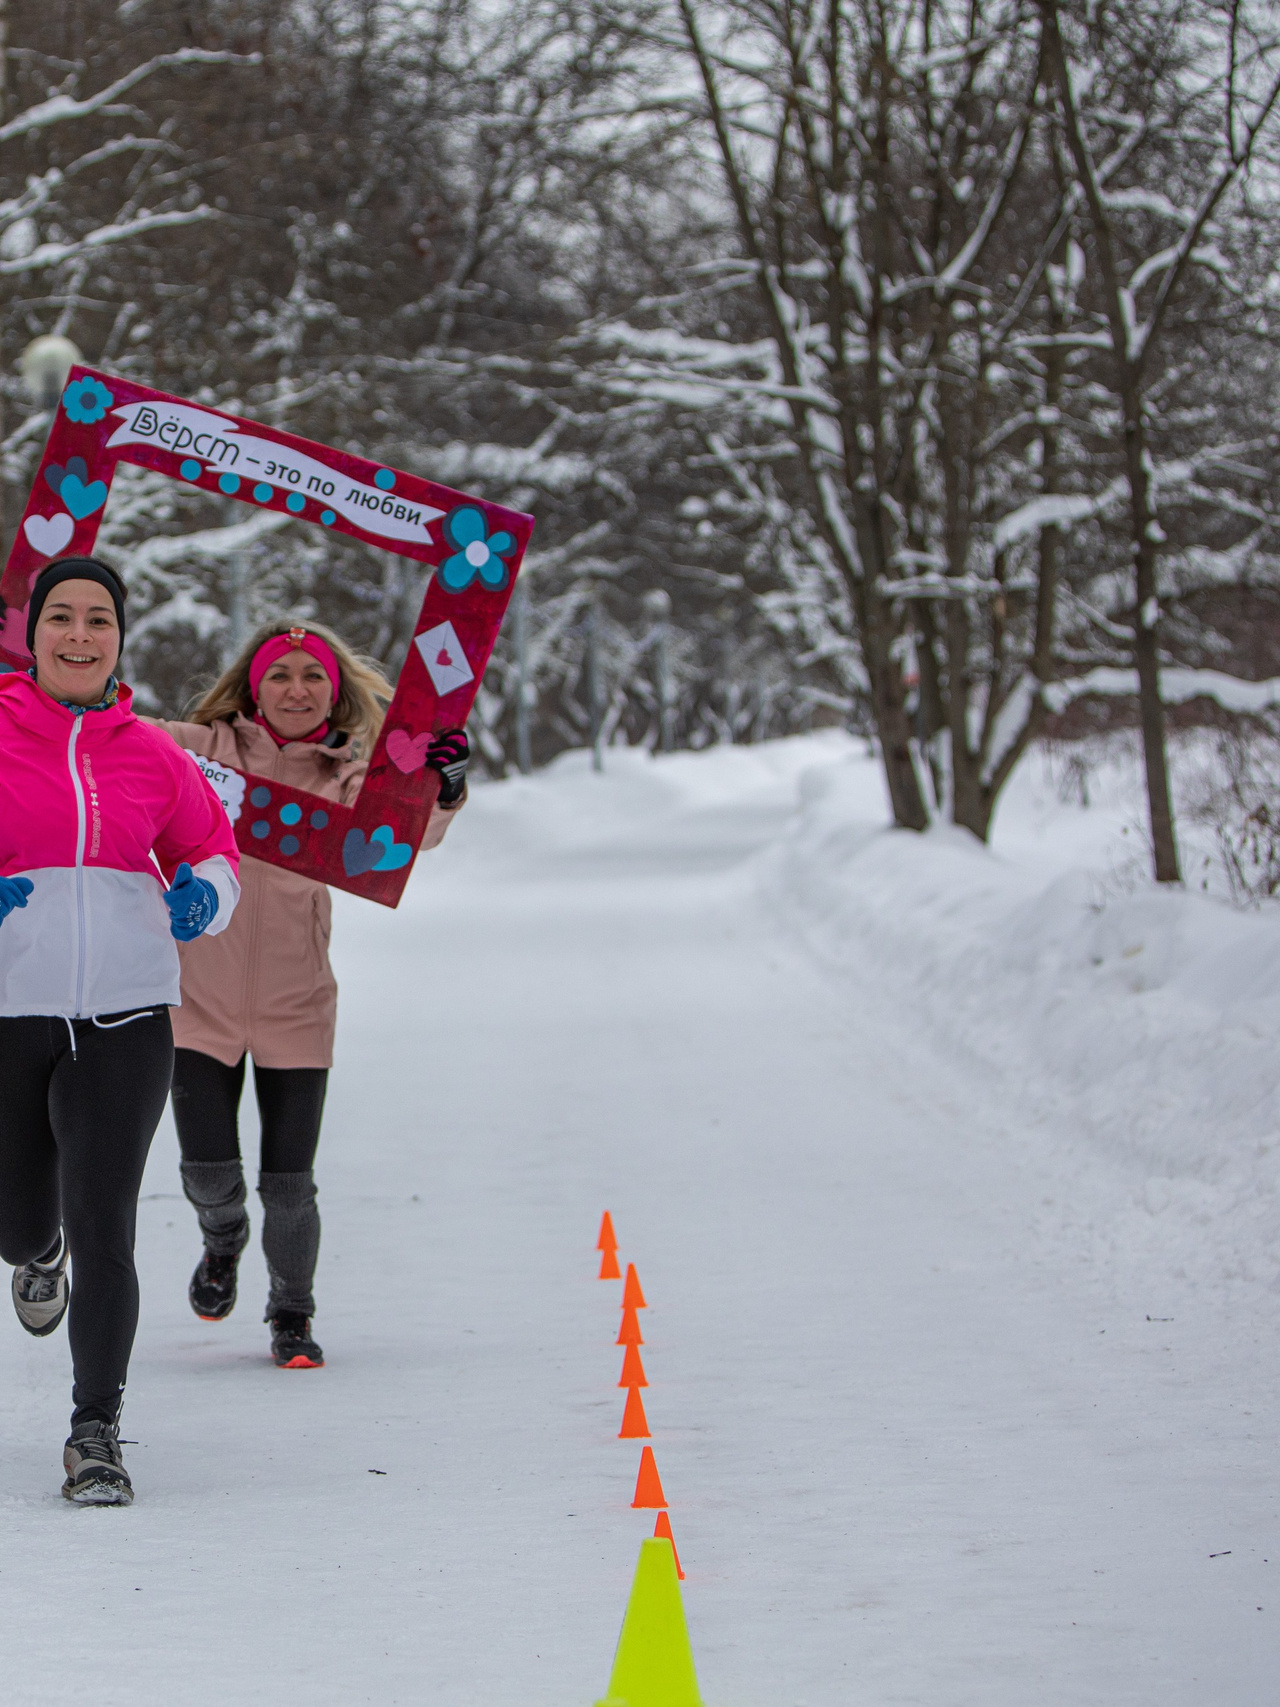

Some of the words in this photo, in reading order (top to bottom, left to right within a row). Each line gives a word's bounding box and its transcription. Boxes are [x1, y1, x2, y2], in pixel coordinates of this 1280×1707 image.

[263, 460, 302, 485] это
[306, 475, 336, 497] по
[344, 488, 423, 526] любви
[198, 761, 229, 784] ёрст
[88, 807, 102, 859] ARMOUR
